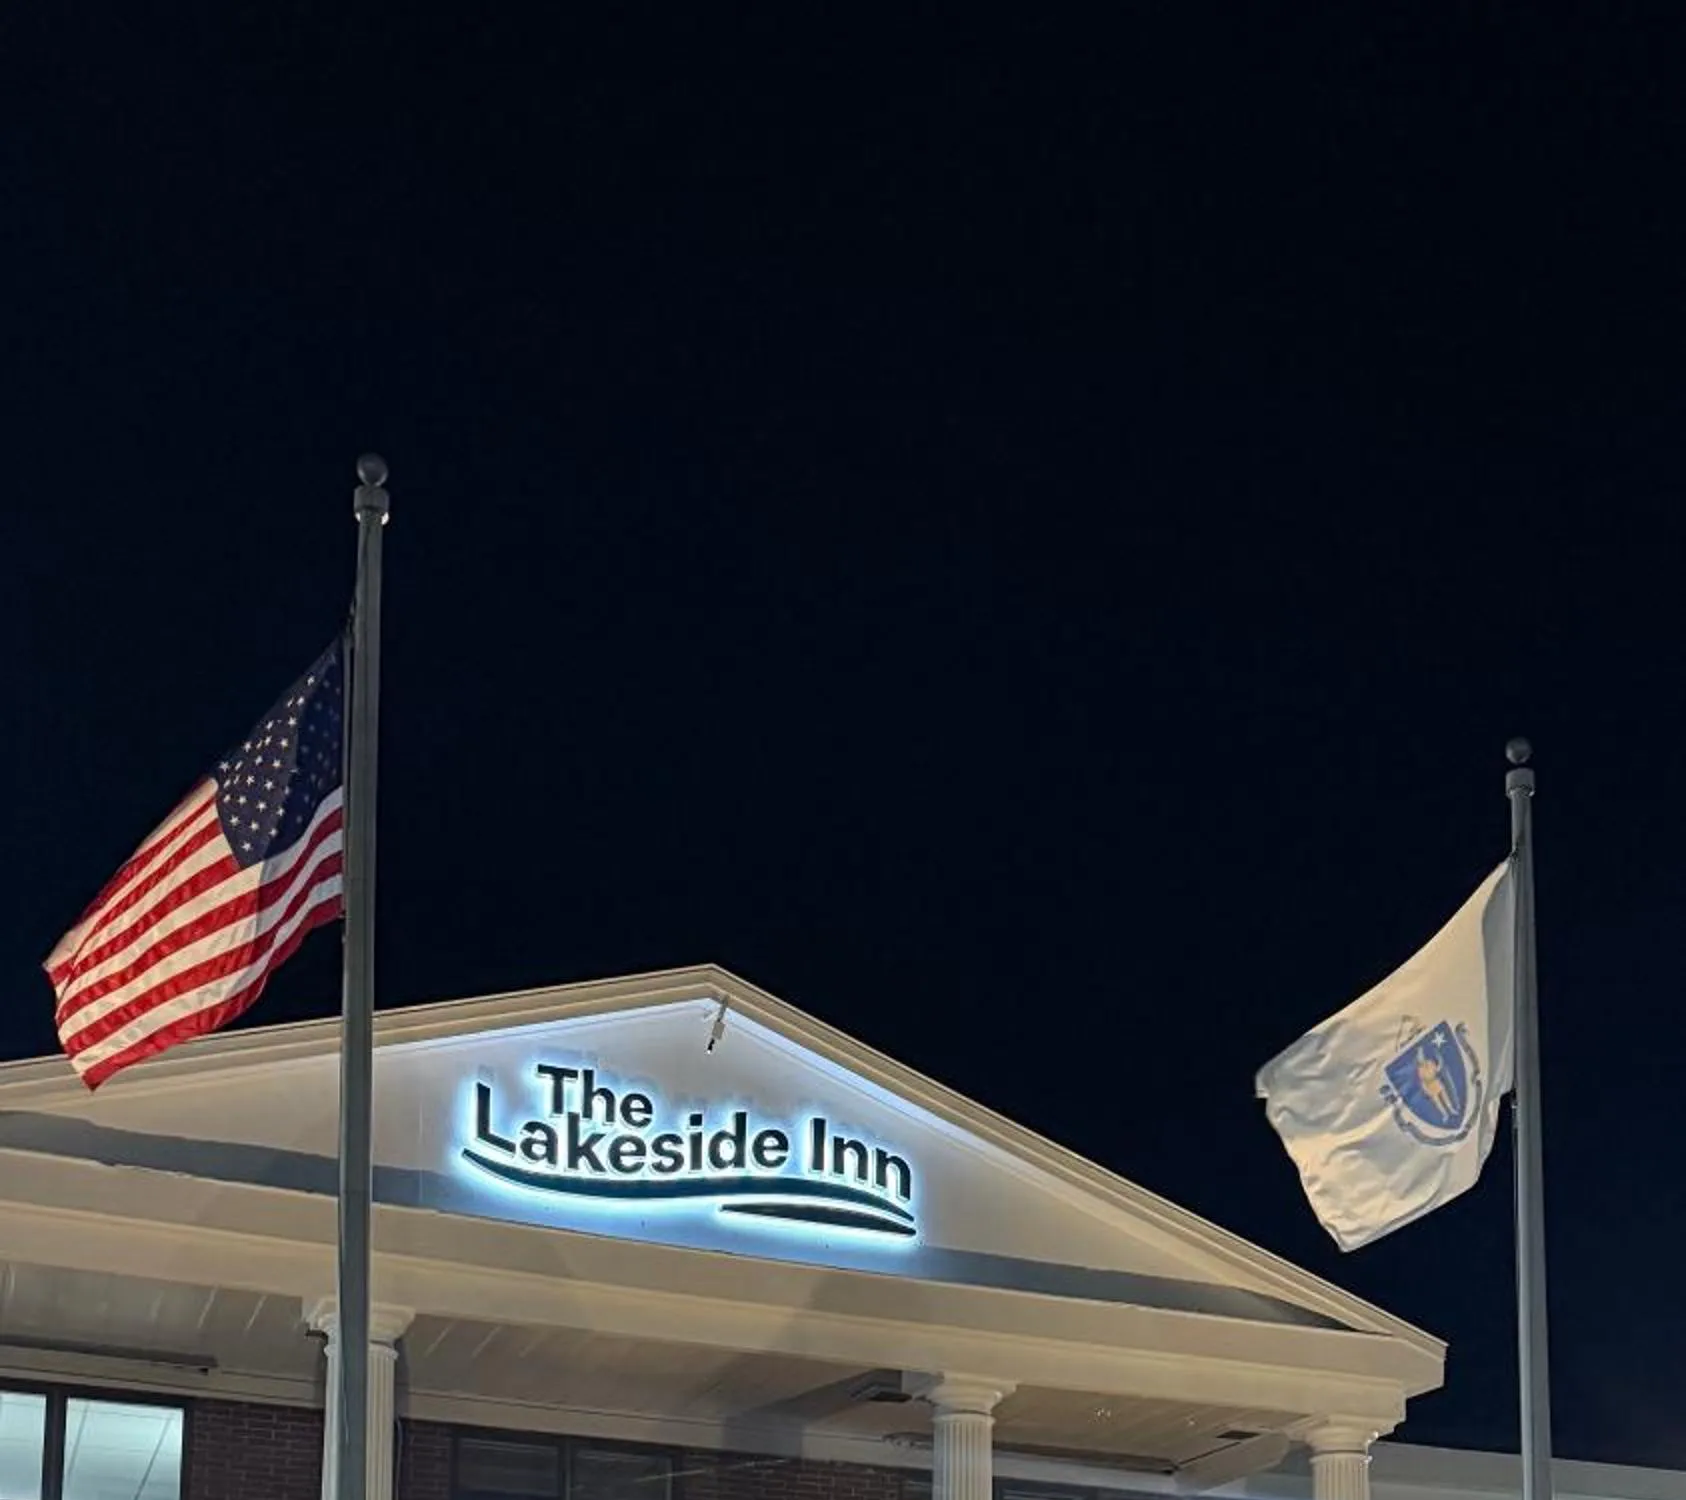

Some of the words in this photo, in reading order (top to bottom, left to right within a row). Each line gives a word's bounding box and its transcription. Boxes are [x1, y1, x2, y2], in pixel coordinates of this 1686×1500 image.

[475, 1081, 790, 1174] Lakeside
[810, 1117, 913, 1202] Inn
[536, 1063, 654, 1129] The
